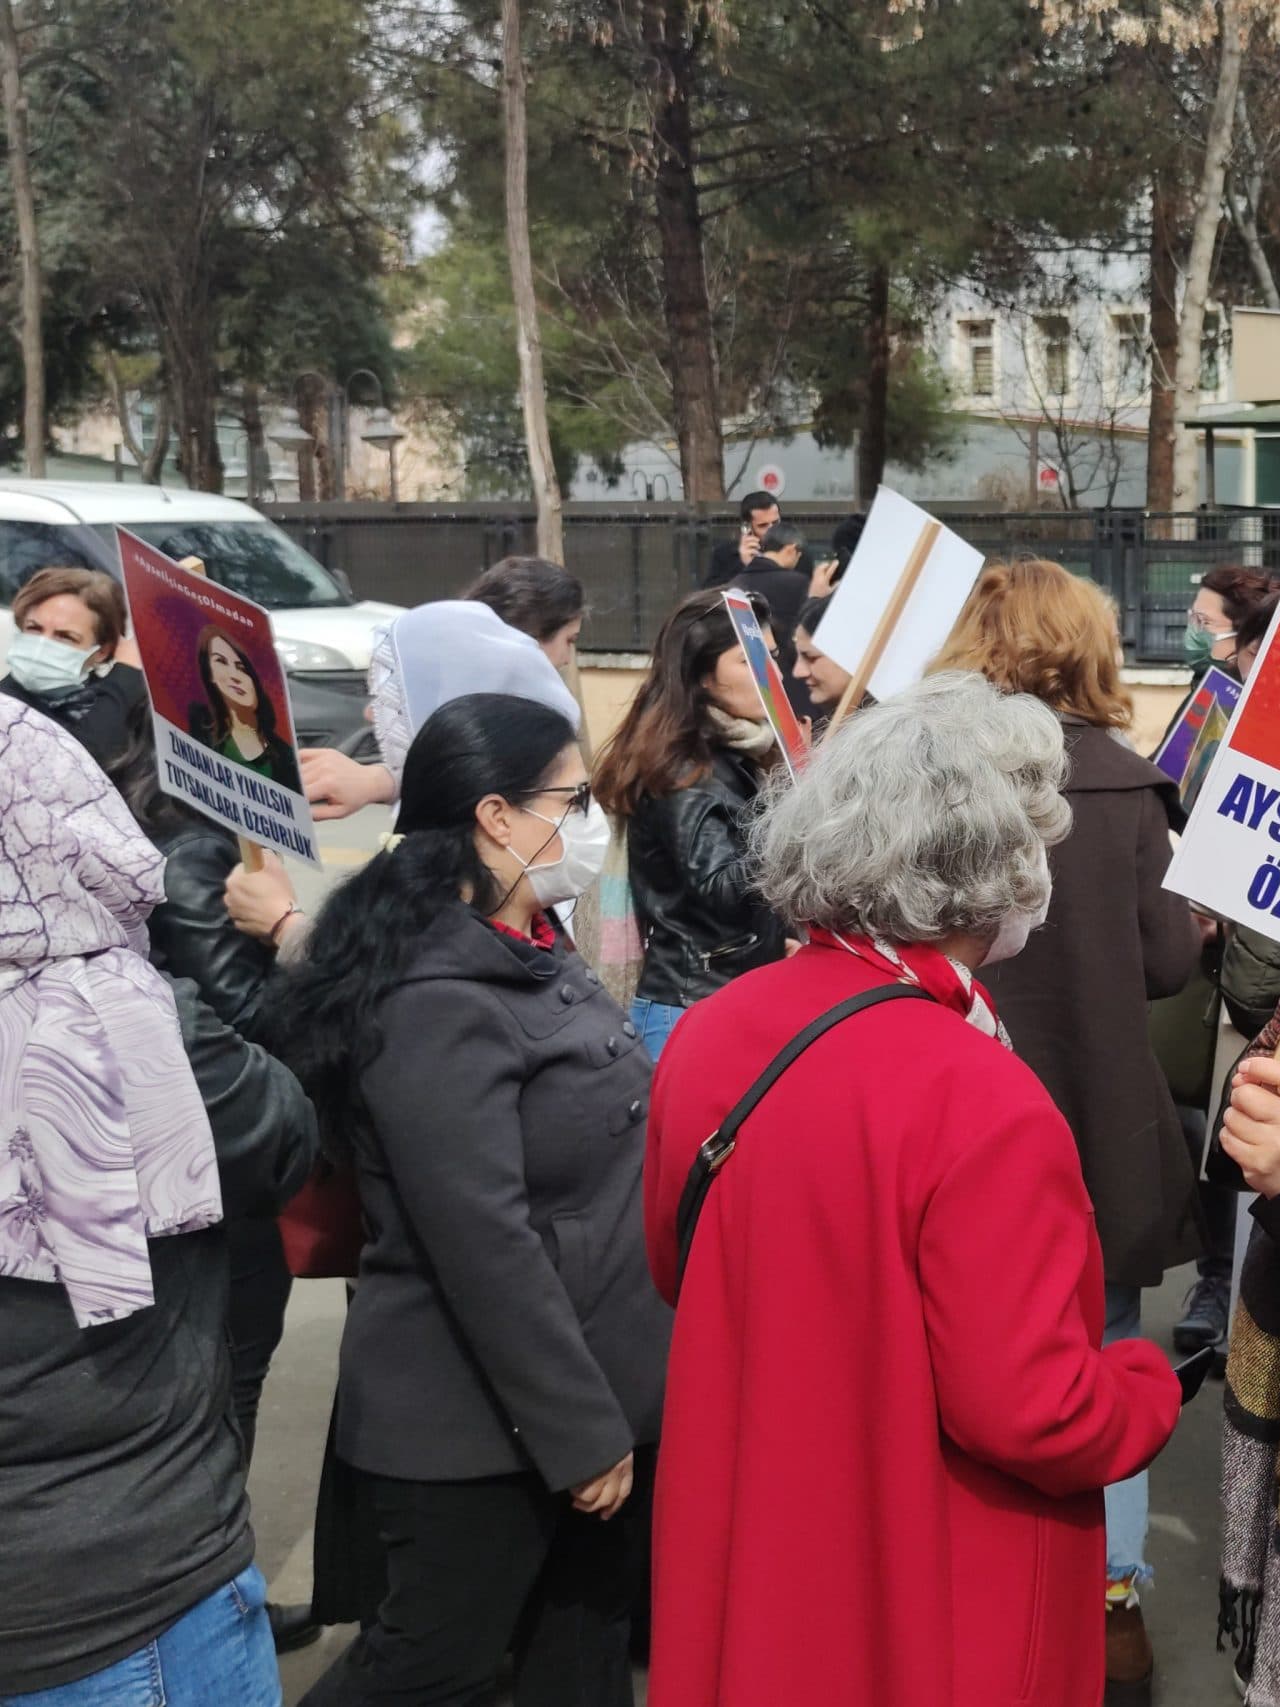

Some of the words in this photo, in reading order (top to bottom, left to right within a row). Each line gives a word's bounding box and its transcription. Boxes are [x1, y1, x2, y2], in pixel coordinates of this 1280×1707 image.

[165, 760, 243, 826] TUTSAKLARA
[242, 803, 316, 861] ÖZGÜRLÜK
[169, 731, 235, 791] ZİNDANLAR
[235, 772, 295, 820] YIKILSIN
